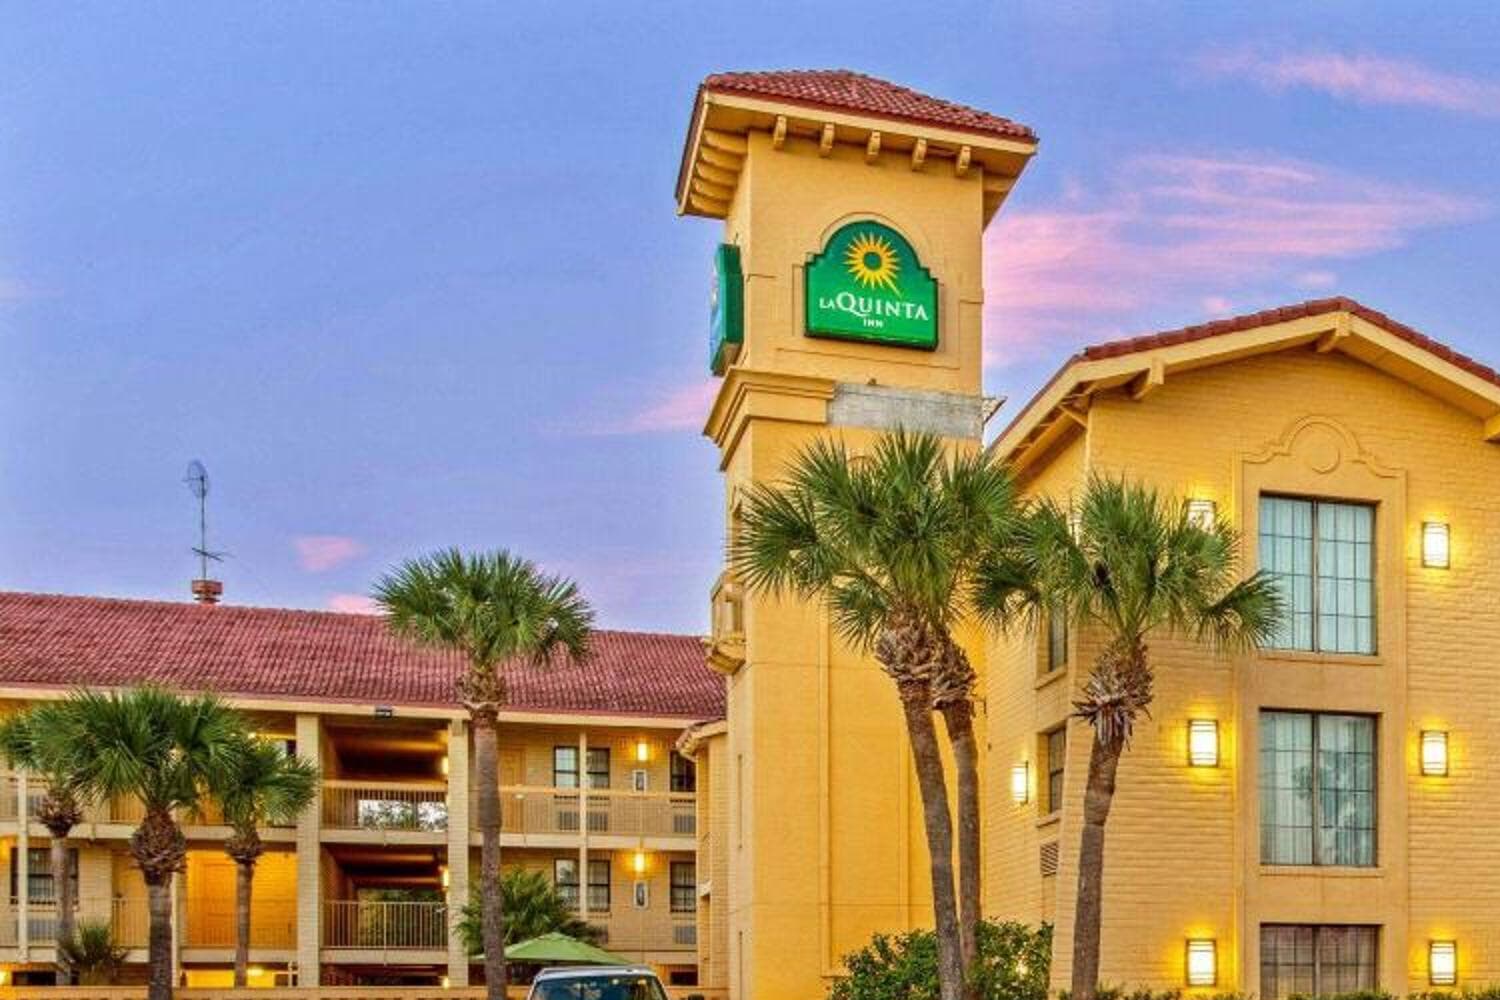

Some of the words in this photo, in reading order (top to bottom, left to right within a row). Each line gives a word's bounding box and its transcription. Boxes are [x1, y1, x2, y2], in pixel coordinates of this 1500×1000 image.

[819, 298, 835, 310] LA
[836, 292, 928, 321] QUINTA
[863, 319, 883, 328] INN
